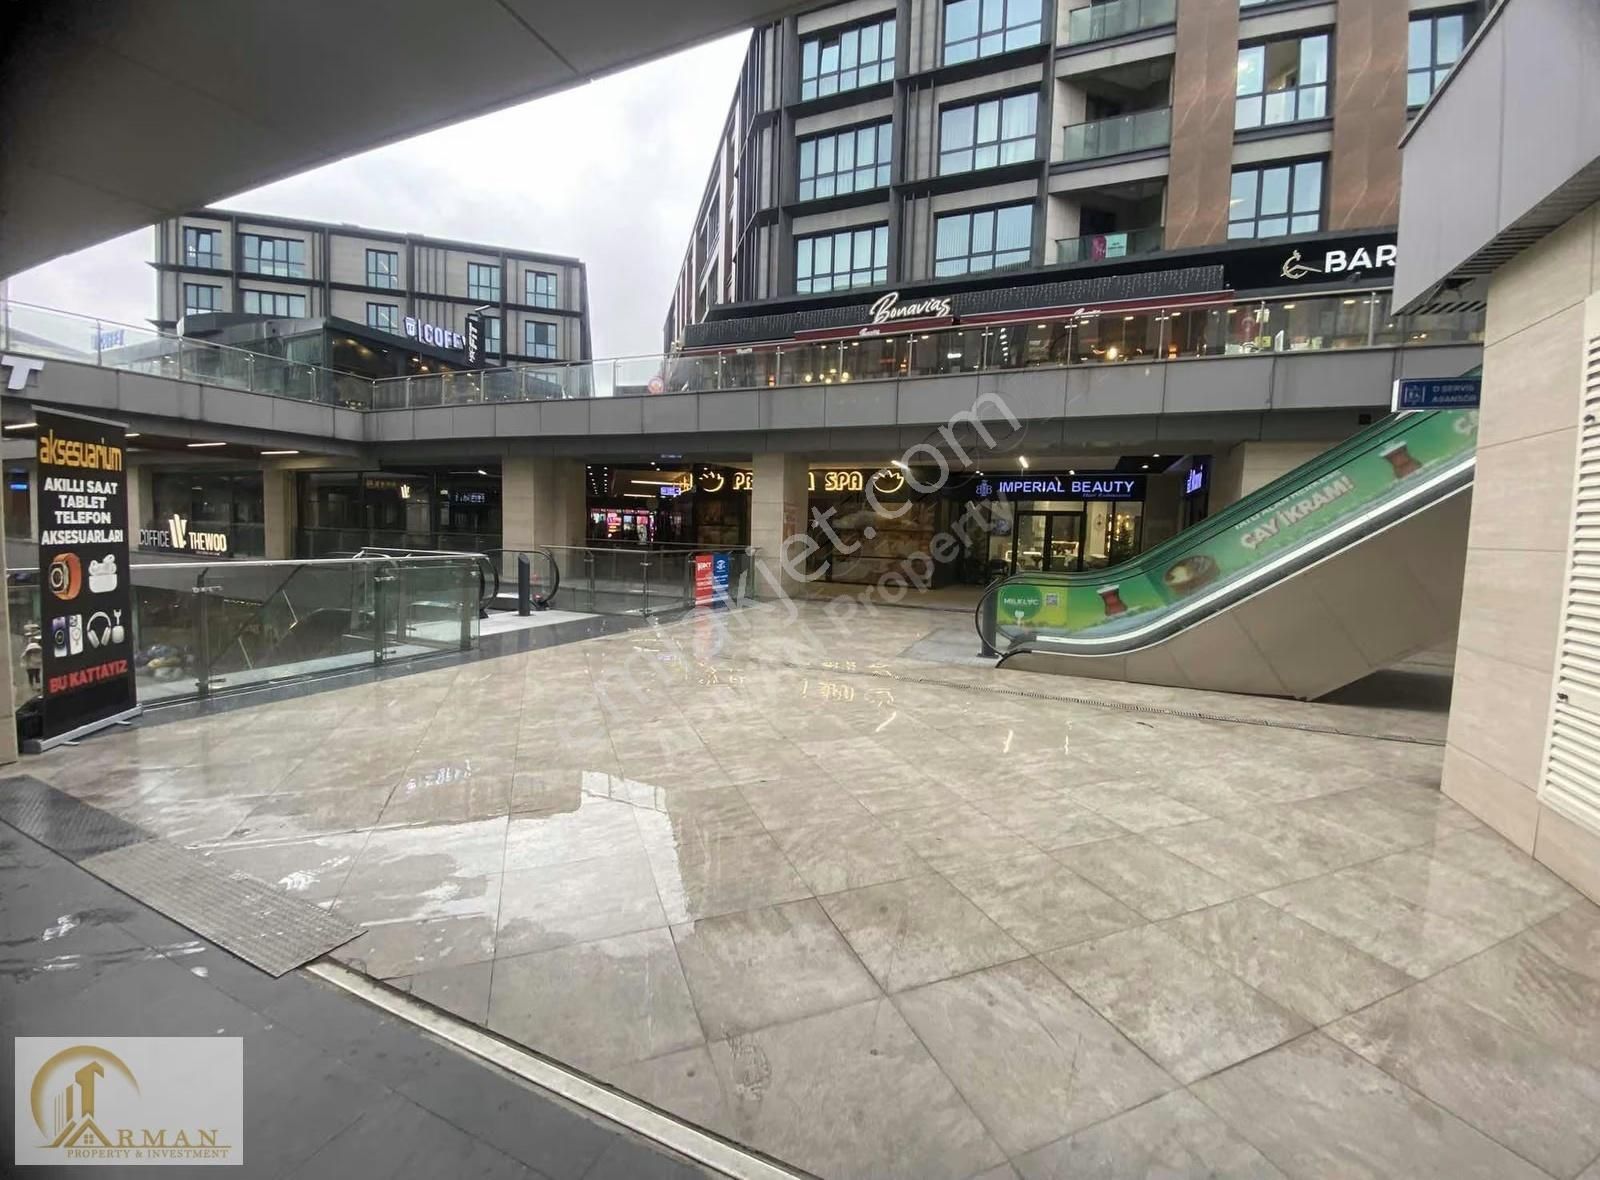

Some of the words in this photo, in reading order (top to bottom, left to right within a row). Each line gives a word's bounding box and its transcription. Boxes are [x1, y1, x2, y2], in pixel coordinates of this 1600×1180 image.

[869, 291, 951, 324] Bonavias
[40, 429, 122, 471] aksesuarium
[44, 477, 84, 492] AKILLI
[87, 480, 118, 494] SAAT
[825, 471, 863, 490] SPA
[999, 480, 1065, 493] IMPERIAL
[1071, 480, 1134, 493] BEAUTY
[58, 495, 107, 509] TABLET
[54, 511, 111, 524] TELEFON
[41, 529, 123, 545] AKSESUARLARI
[1240, 516, 1282, 549] ÇAY
[49, 674, 68, 694] BU
[68, 659, 128, 687] KATTAYIZ
